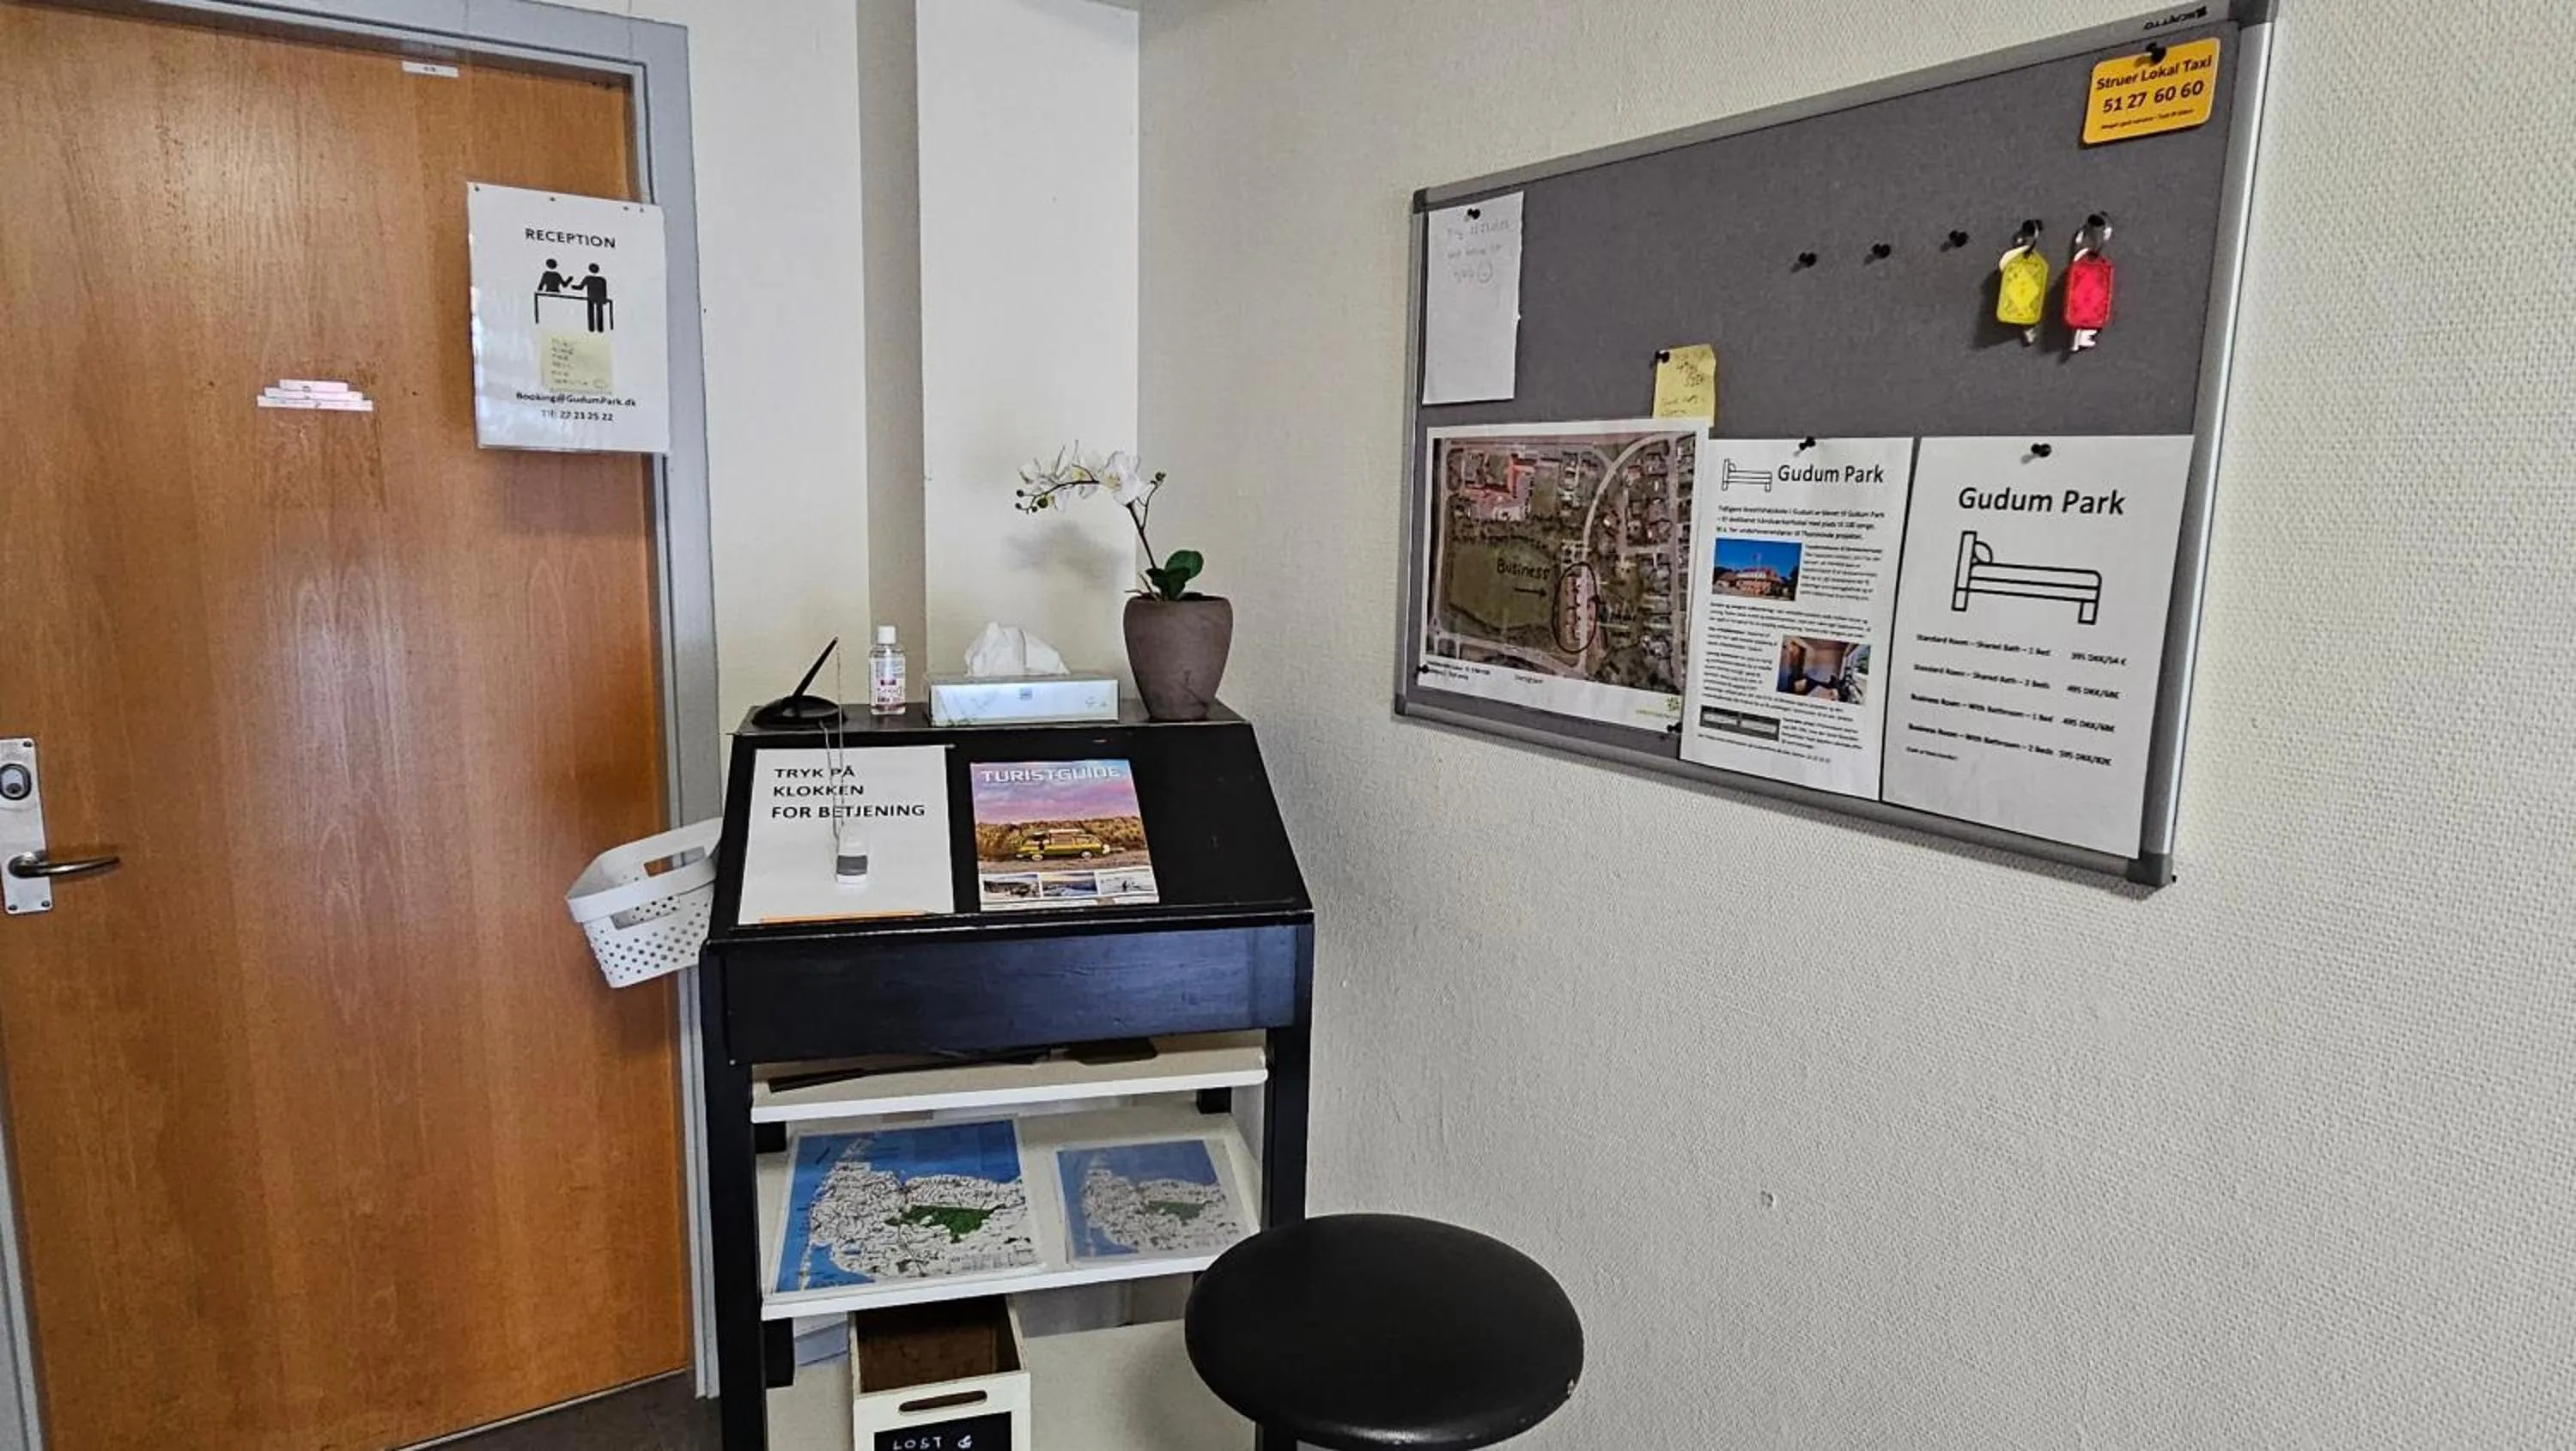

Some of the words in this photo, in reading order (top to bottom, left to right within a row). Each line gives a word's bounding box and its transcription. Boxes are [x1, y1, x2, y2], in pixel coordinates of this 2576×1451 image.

[2096, 73, 2137, 90] Struer
[2141, 64, 2178, 82] Lokal
[2184, 55, 2213, 70] Taxi
[2102, 98, 2123, 113] 51
[2127, 92, 2148, 109] 27
[2154, 87, 2176, 103] 60
[2180, 80, 2204, 98] 60
[525, 228, 616, 248] RECEPTION
[1777, 464, 1839, 483] Gudum
[1844, 464, 1885, 483] Park
[1959, 487, 2052, 513] Gudum
[2062, 489, 2125, 515] Park
[1497, 558, 1550, 580] Business
[774, 768, 823, 779] TRYK
[830, 765, 855, 778] PÅ
[981, 766, 1120, 783] TURISTGUIDE
[774, 786, 864, 797] KLOKKEN
[773, 806, 811, 818] FOR
[818, 804, 925, 818] BETJENING
[892, 1436, 943, 1450] LOST
